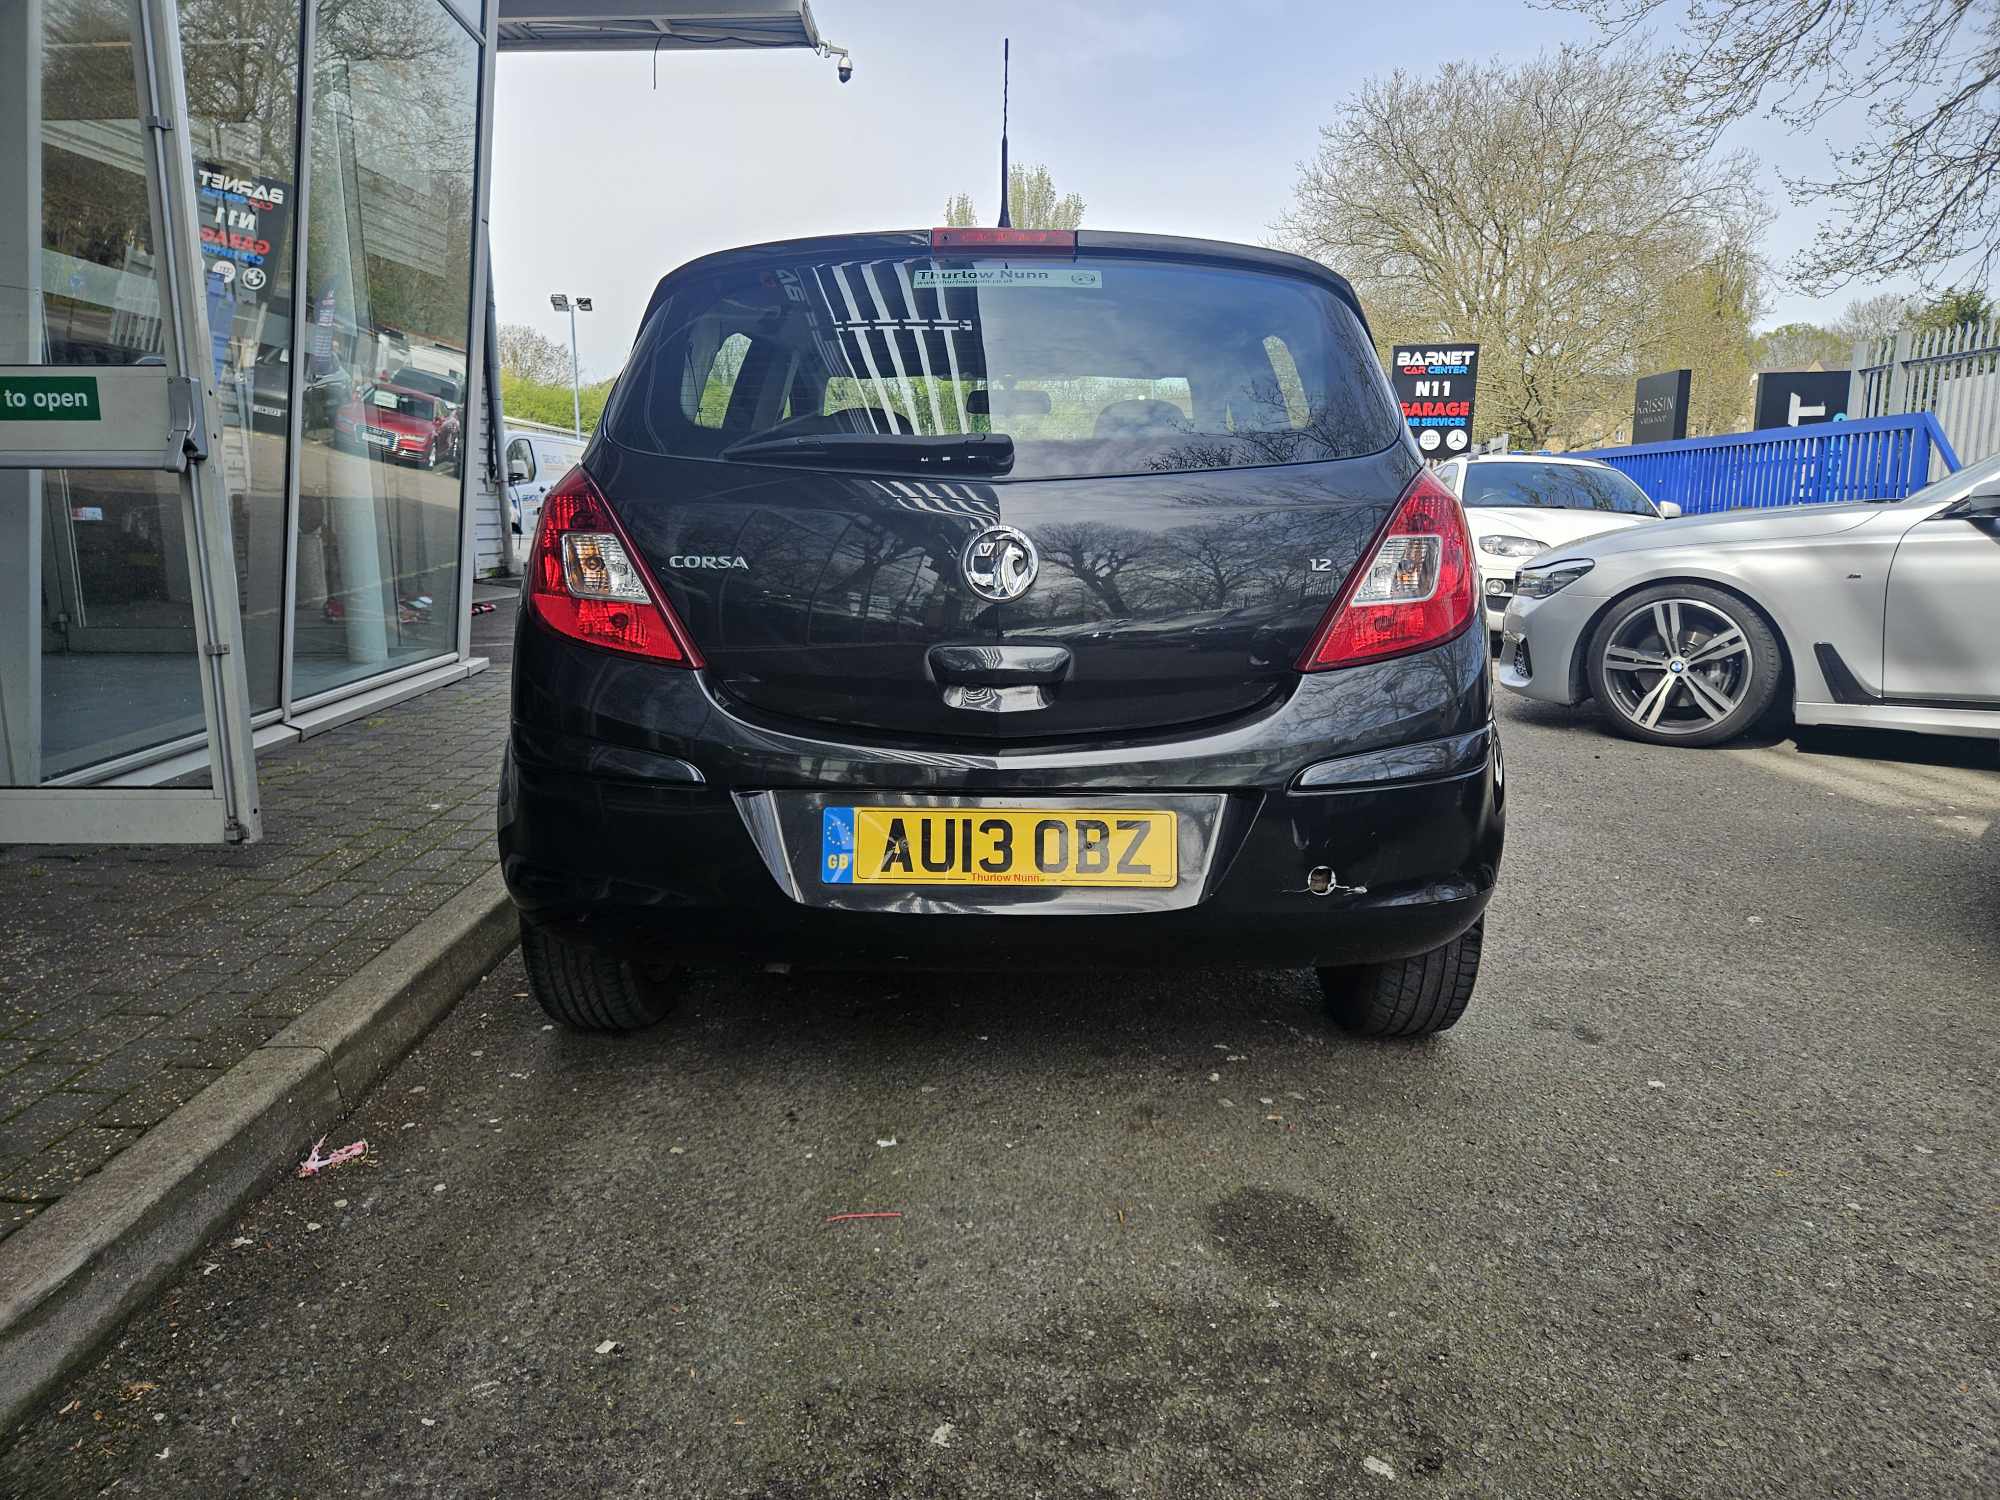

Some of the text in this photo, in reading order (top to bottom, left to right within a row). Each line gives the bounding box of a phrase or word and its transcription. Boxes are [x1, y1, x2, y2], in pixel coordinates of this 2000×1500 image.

[918, 270, 1049, 280] Thurlow Nunn
[1397, 351, 1475, 366] BARNET
[1403, 366, 1468, 375] CAR CENTER
[1415, 381, 1451, 397] N11
[4, 389, 88, 412] to open
[1407, 417, 1466, 427] AR SERVICES
[669, 555, 750, 569] CORSA
[880, 818, 1013, 874] AU13
[827, 855, 849, 870] GB
[972, 873, 1010, 882] Thurlow
[1013, 873, 1040, 882] Nunn
